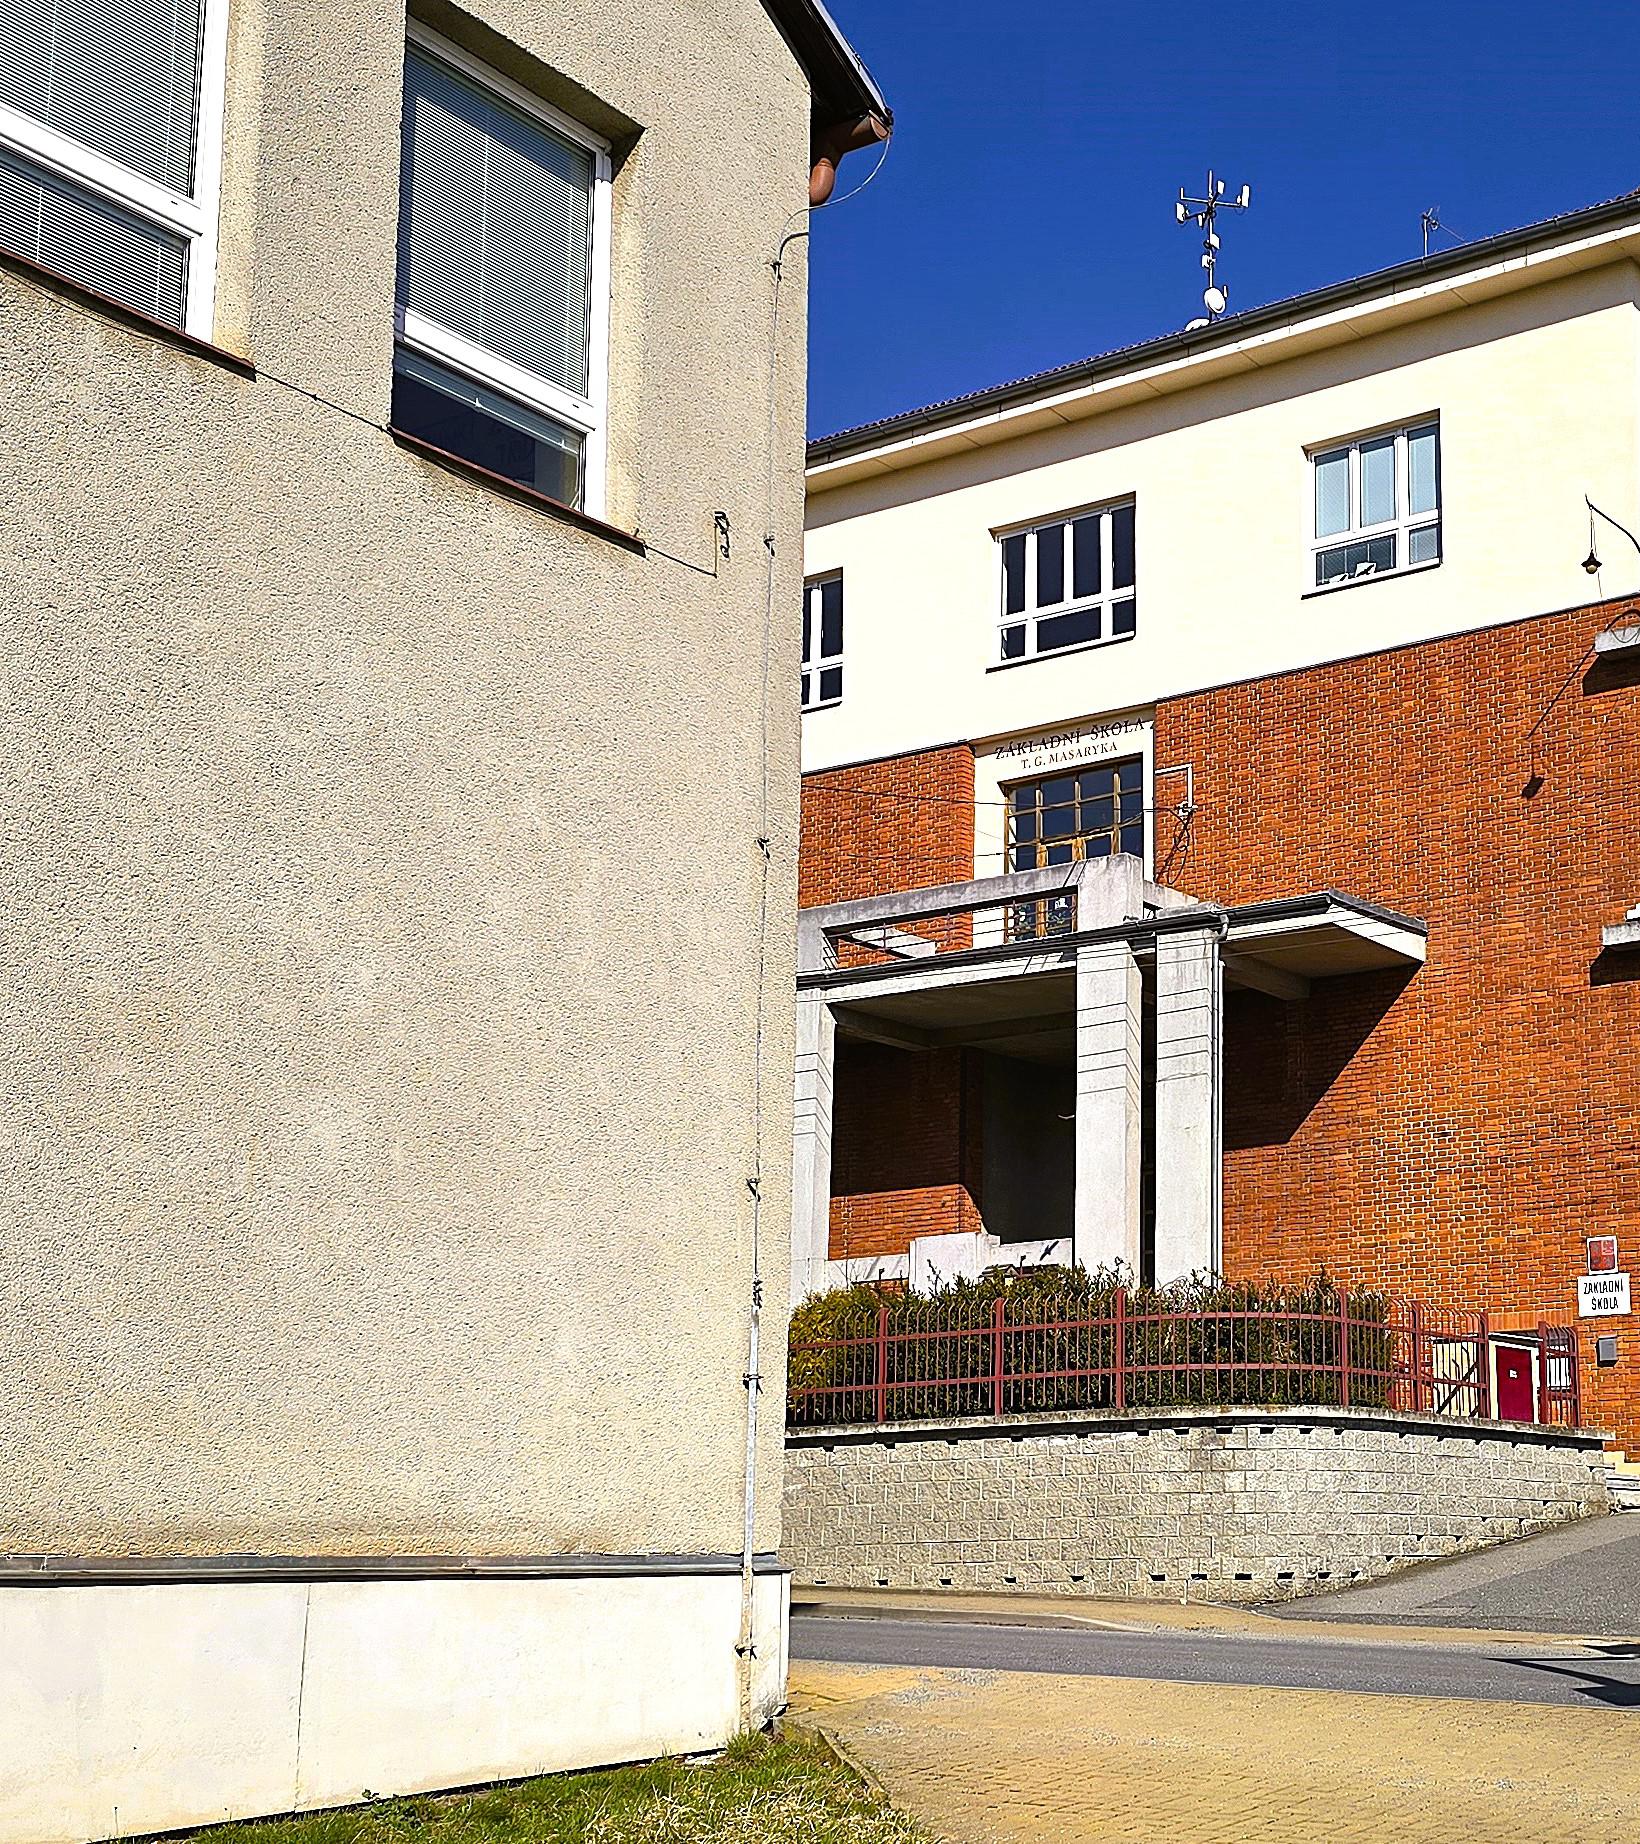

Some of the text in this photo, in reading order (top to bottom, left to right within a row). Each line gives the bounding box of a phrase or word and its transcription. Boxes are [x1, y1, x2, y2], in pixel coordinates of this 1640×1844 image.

[995, 717, 1145, 760] ZÁKLADNÍ ŠKOLA
[1021, 741, 1118, 769] T. G. MASARYKA
[1591, 1296, 1619, 1310] ŠKOLA
